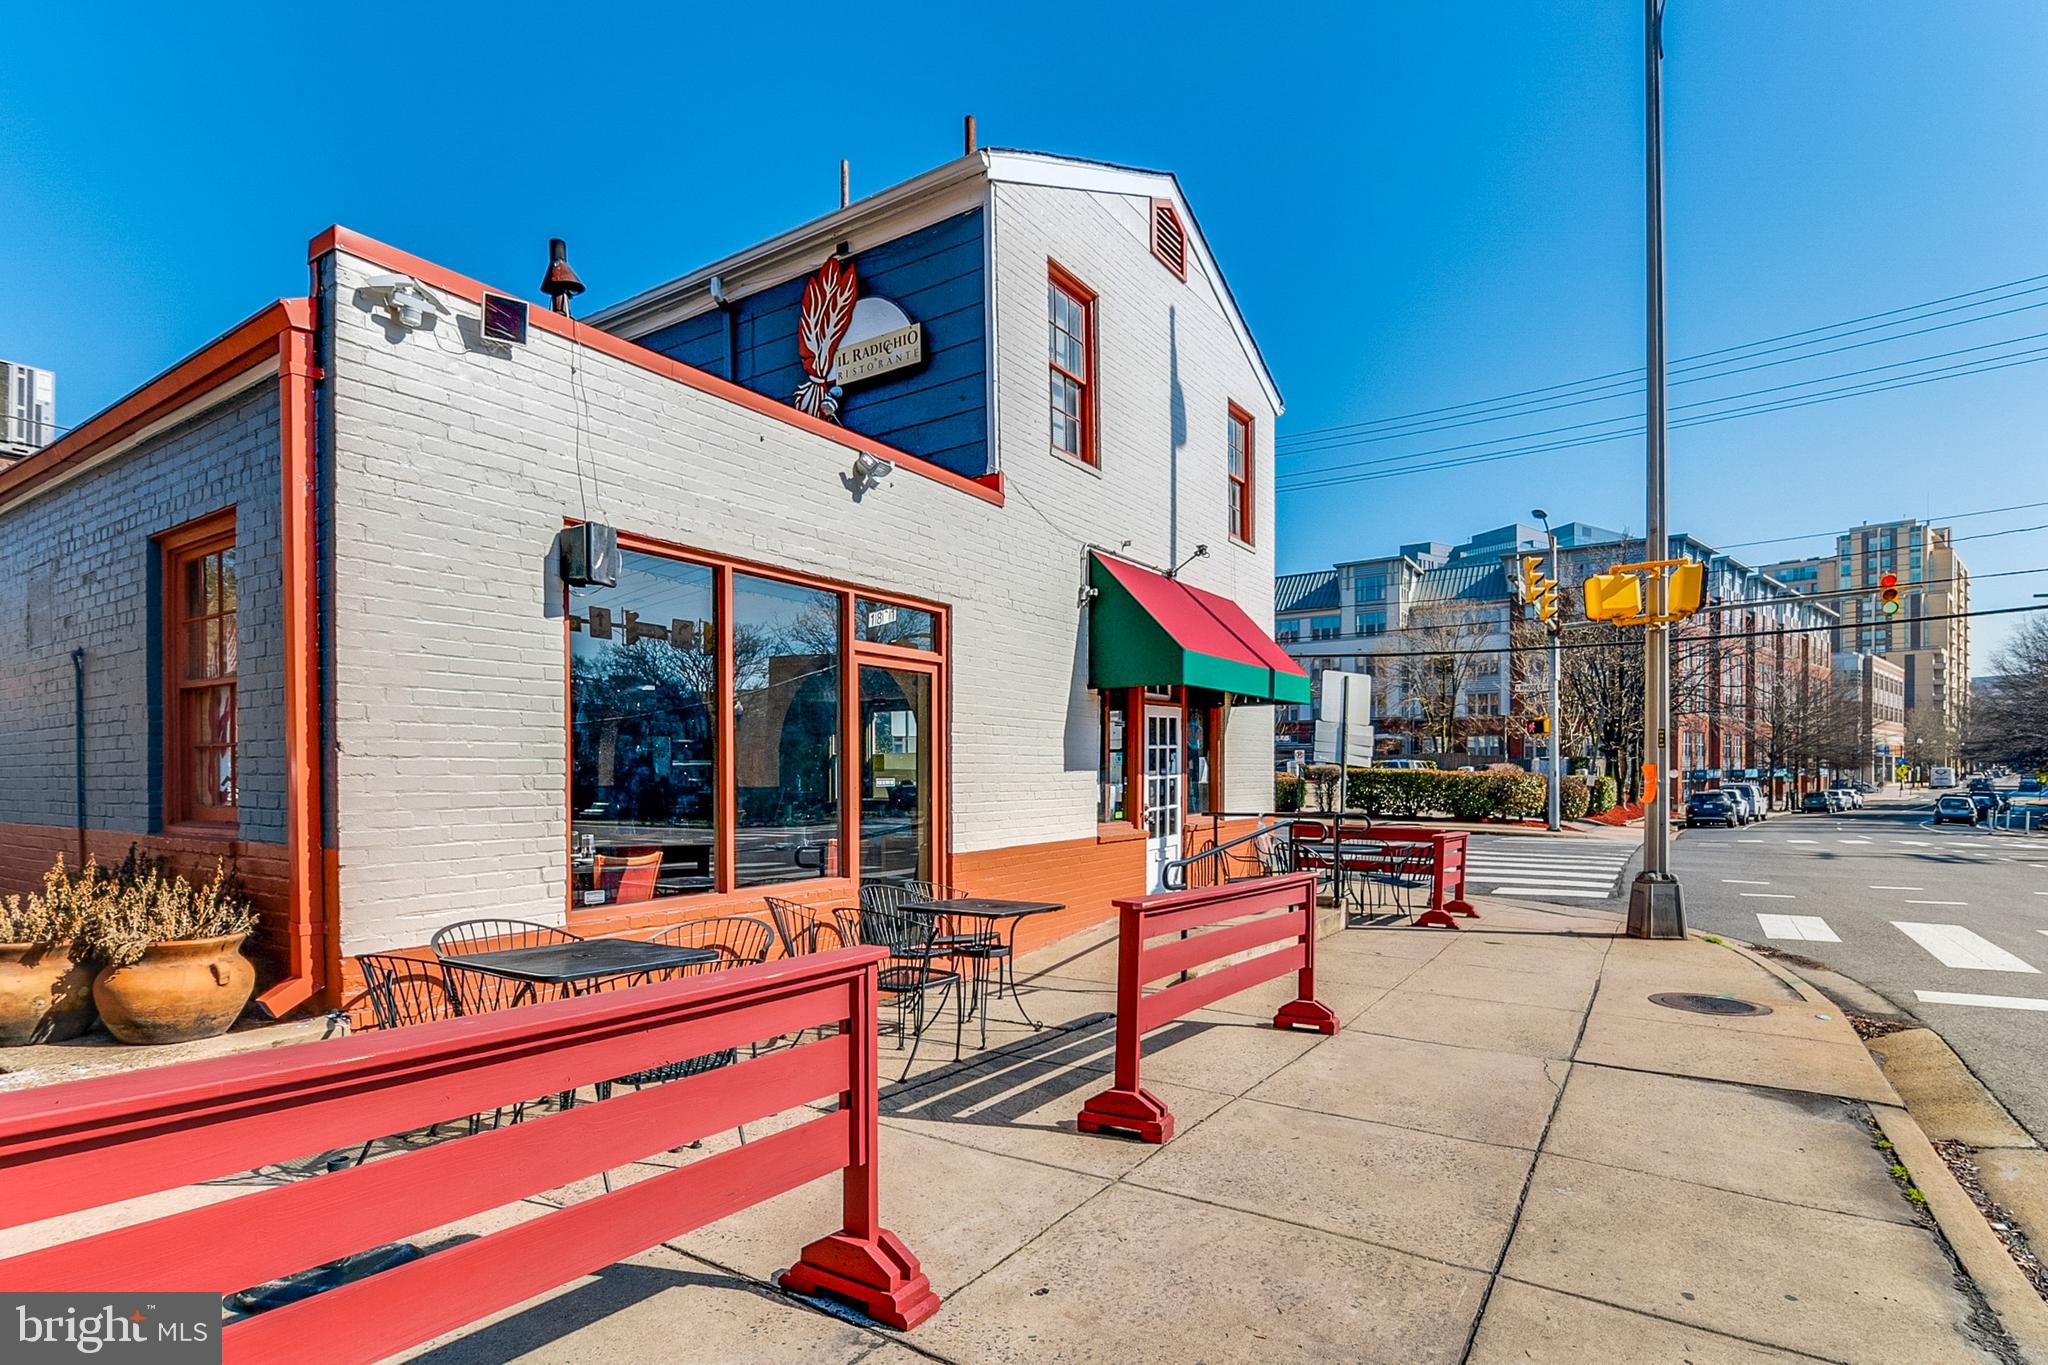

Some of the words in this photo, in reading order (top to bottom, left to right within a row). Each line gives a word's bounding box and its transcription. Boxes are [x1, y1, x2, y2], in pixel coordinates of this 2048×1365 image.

[837, 348, 919, 380] RISTORANTE
[838, 352, 850, 367] IL
[852, 330, 918, 362] RADICCHIO
